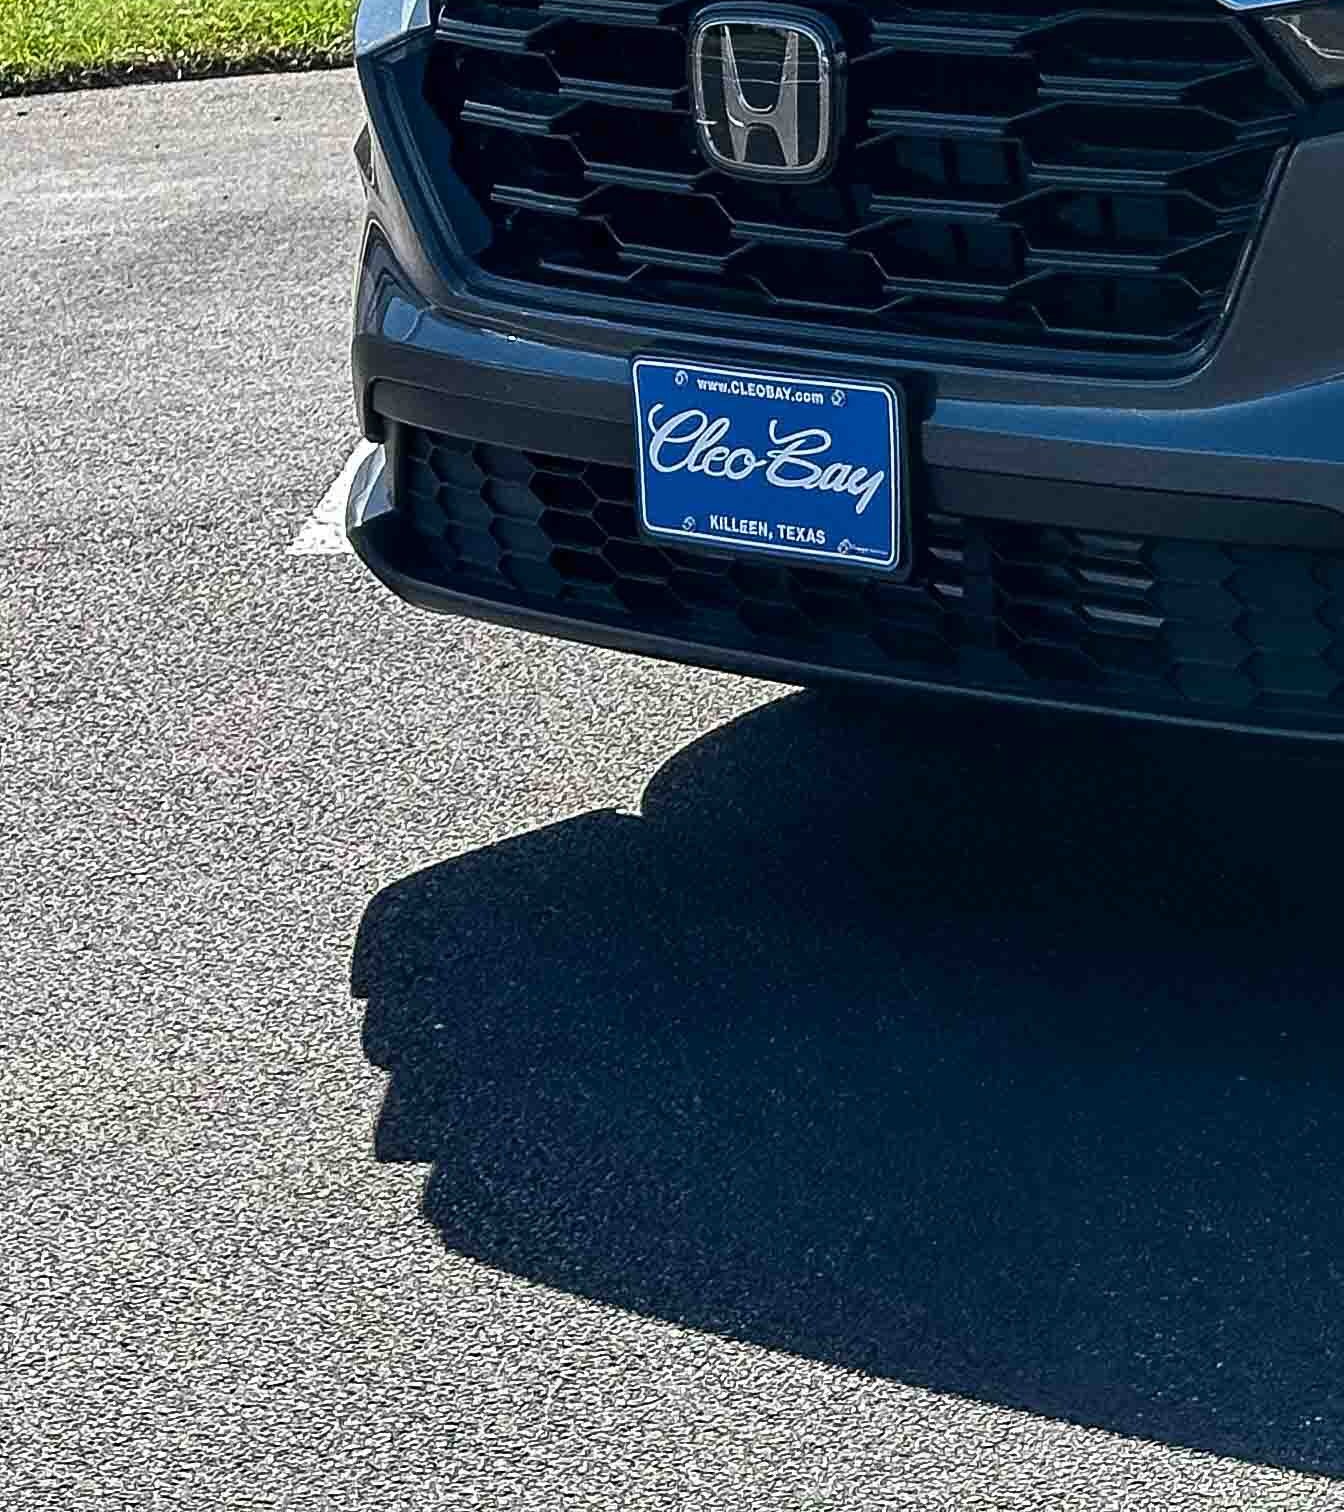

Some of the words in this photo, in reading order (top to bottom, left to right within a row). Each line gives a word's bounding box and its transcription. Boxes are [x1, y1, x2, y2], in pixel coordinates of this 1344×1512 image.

[696, 378, 824, 405] www.CLEOBAY.com
[709, 514, 773, 541] KILLEEN,
[776, 523, 827, 545] TEXAS
